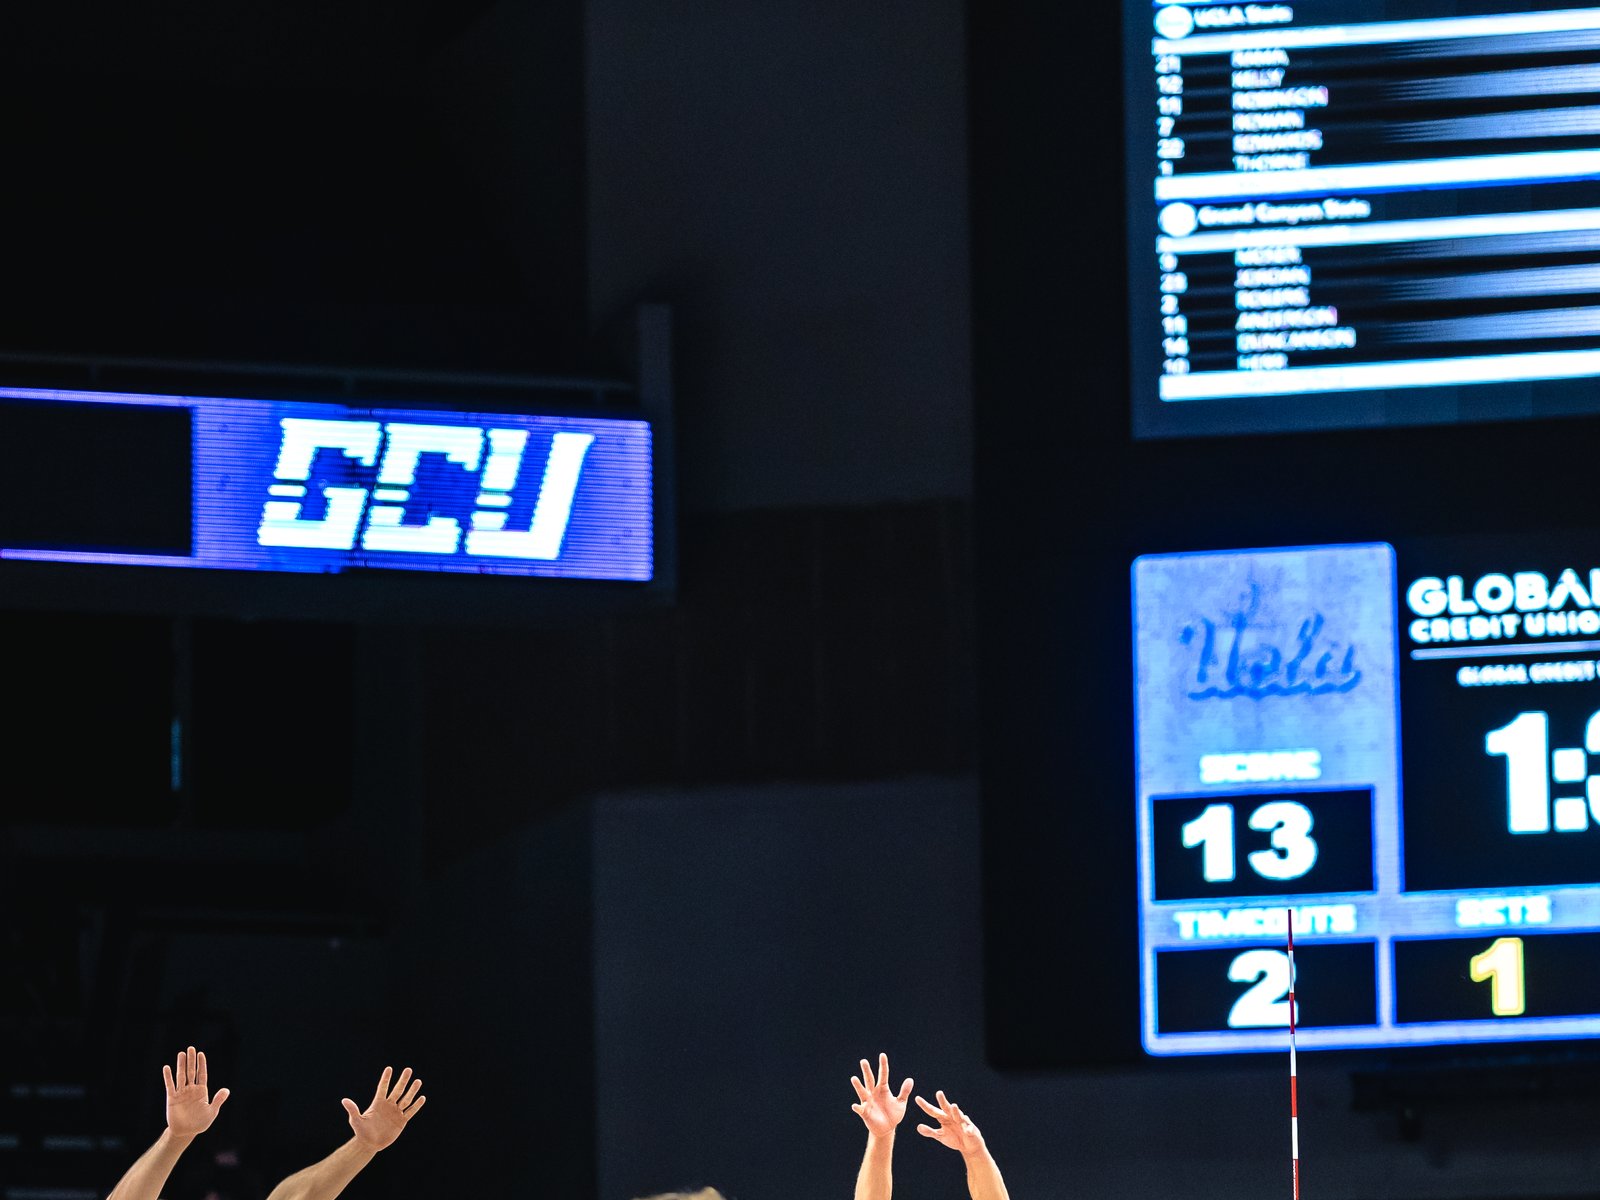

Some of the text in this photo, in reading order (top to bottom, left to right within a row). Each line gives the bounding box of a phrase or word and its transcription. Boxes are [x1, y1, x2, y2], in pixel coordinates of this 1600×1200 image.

[257, 417, 595, 560] GCU
[1409, 609, 1600, 643] CREDIT UNIO
[1200, 749, 1321, 784] SCORE
[1181, 801, 1319, 883] 13
[1174, 904, 1357, 939] TIMEOUTS
[1455, 896, 1552, 926] SETS
[1227, 949, 1299, 1028] 2
[1470, 937, 1525, 1016] 1
